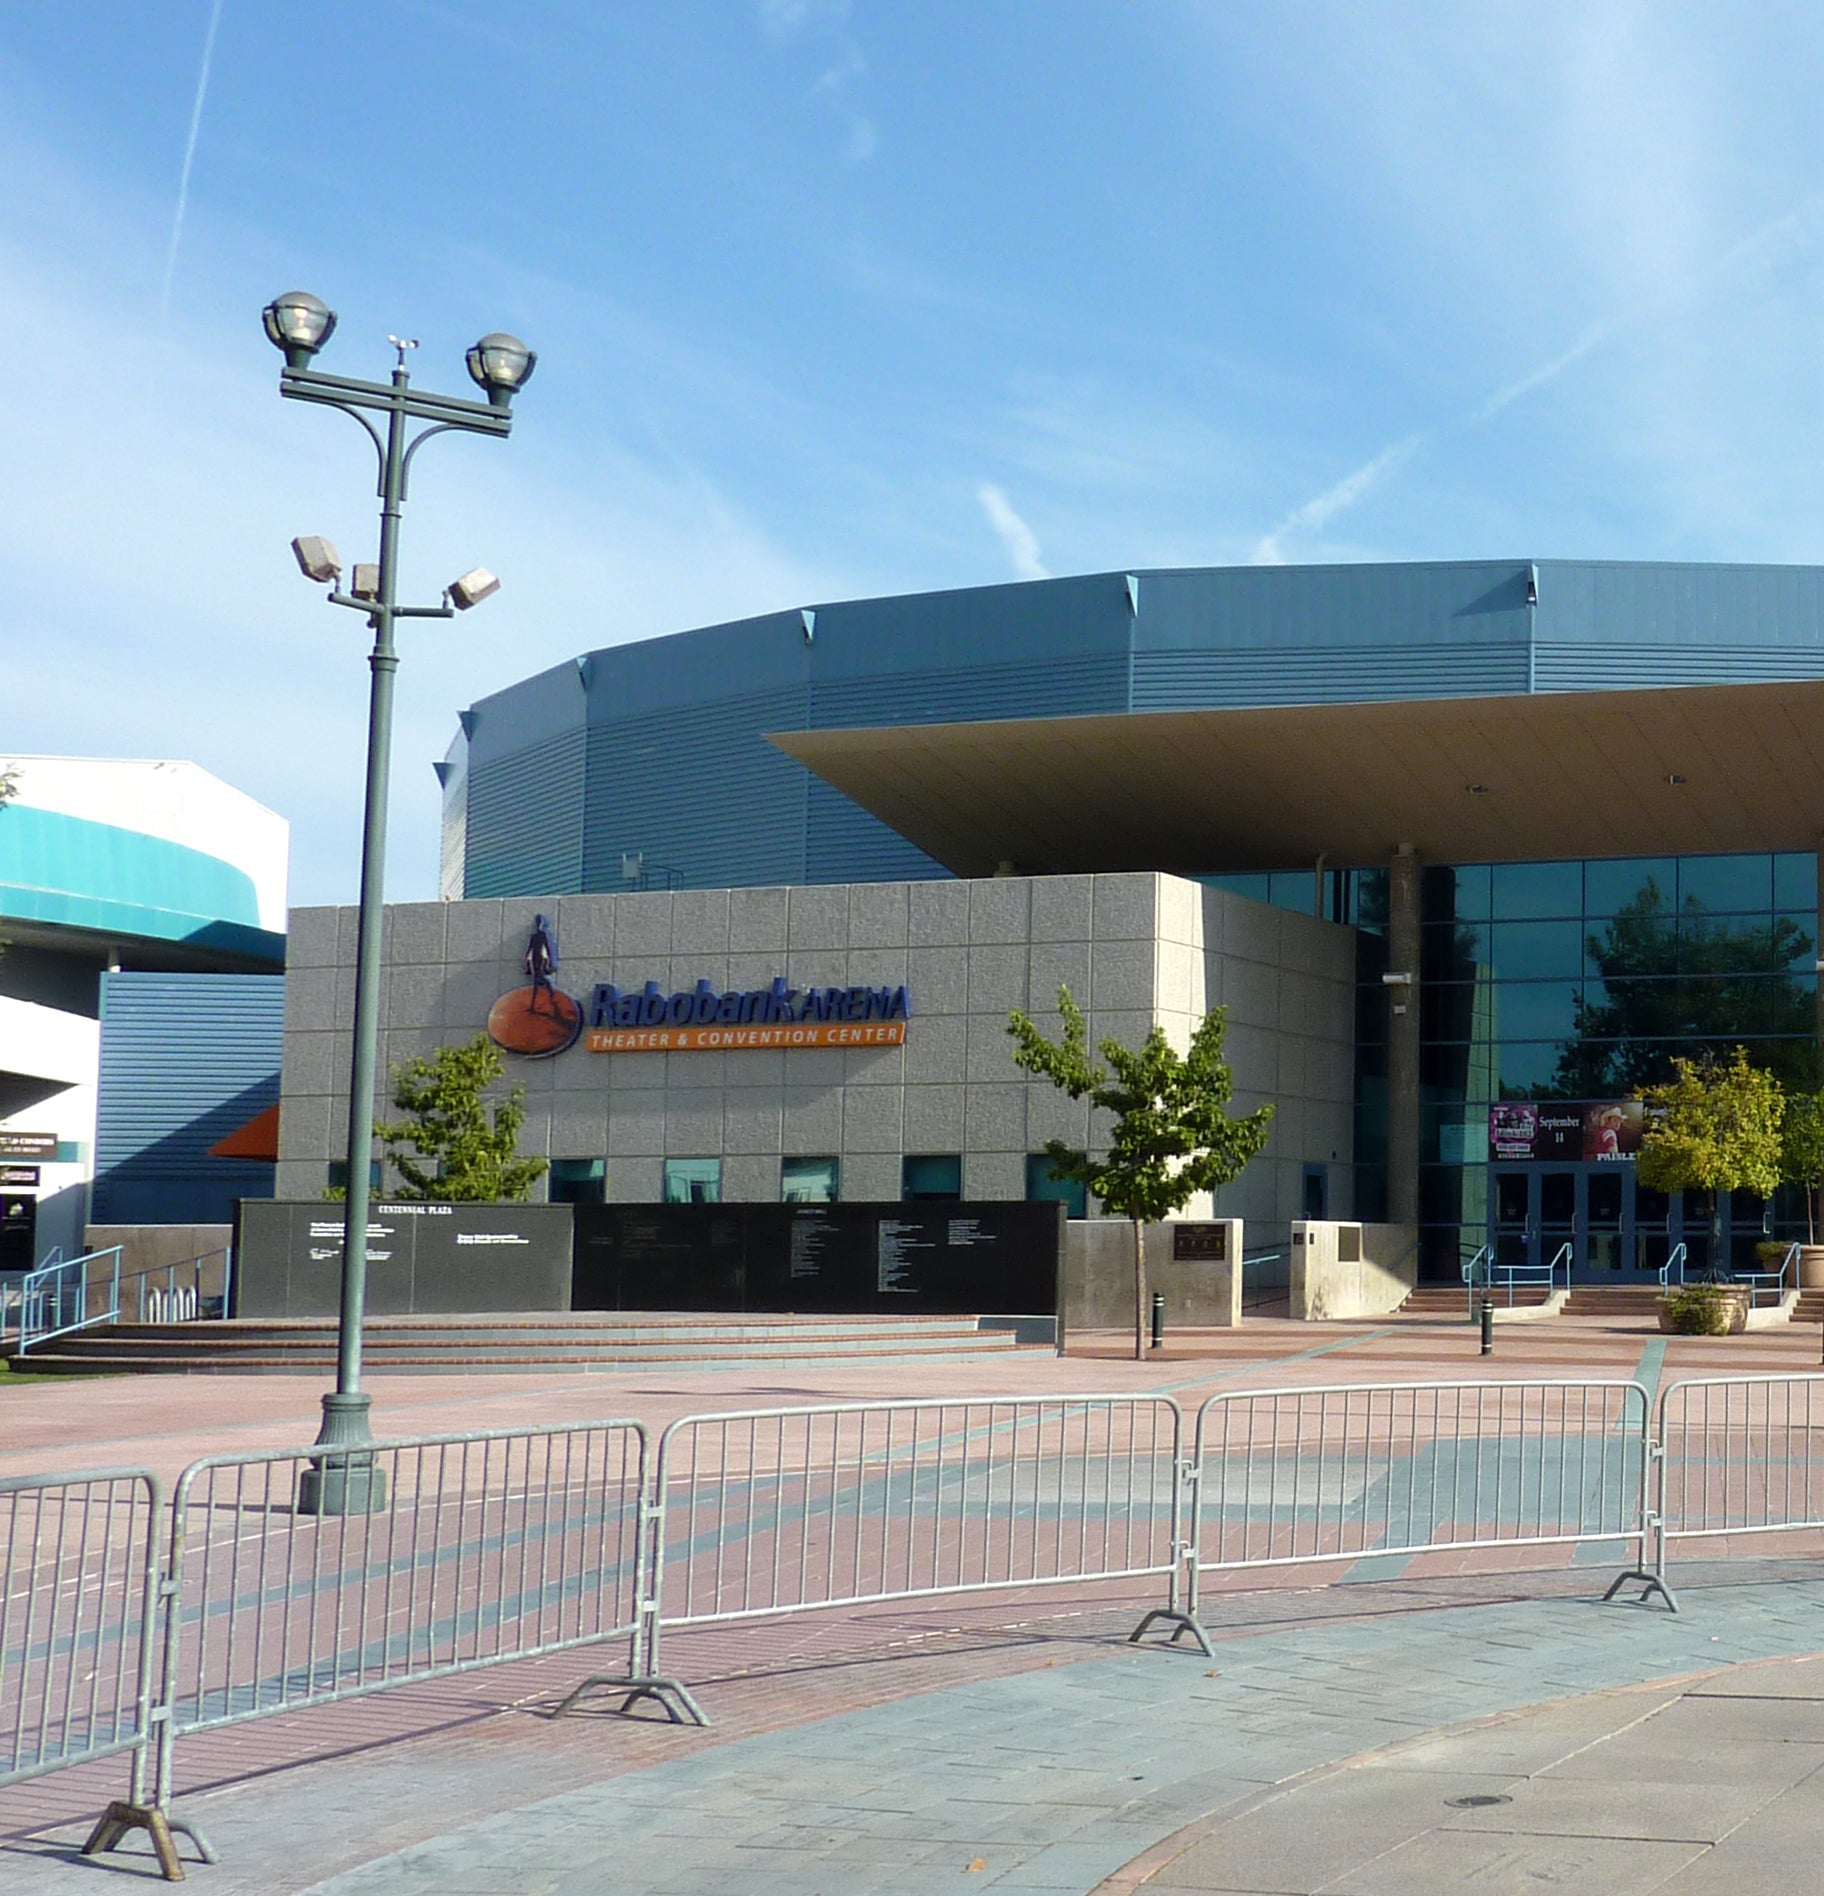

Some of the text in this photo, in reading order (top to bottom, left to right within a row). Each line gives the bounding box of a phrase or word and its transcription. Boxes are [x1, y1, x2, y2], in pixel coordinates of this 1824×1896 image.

[589, 977, 910, 1027] Rabobank ARENA
[592, 1027, 898, 1047] THEATER & CONVENTION CENTER
[1539, 1116, 1580, 1131] September
[1597, 1152, 1637, 1161] PAISLE
[379, 1205, 453, 1215] CENTENNIAL PLAZA
